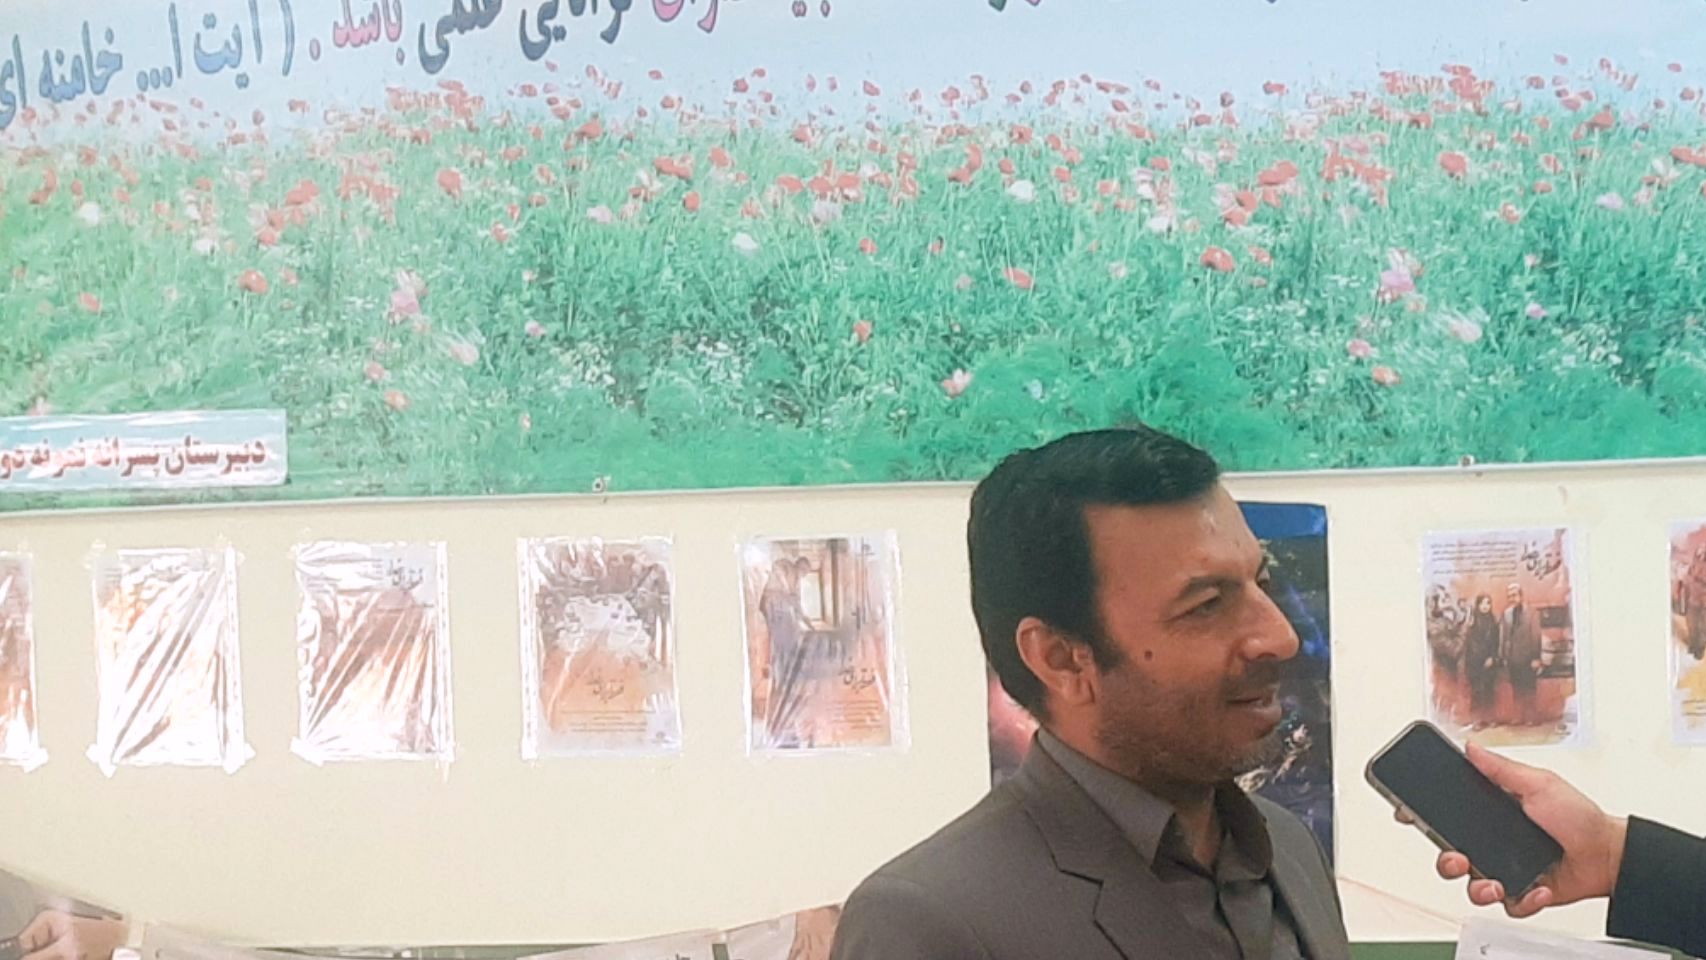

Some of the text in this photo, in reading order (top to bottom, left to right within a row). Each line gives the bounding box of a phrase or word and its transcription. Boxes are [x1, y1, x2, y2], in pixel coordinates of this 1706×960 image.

[39, 20, 123, 103] خامنه
[96, 436, 160, 477] پسرانه
[160, 435, 266, 475] دبیرستان
